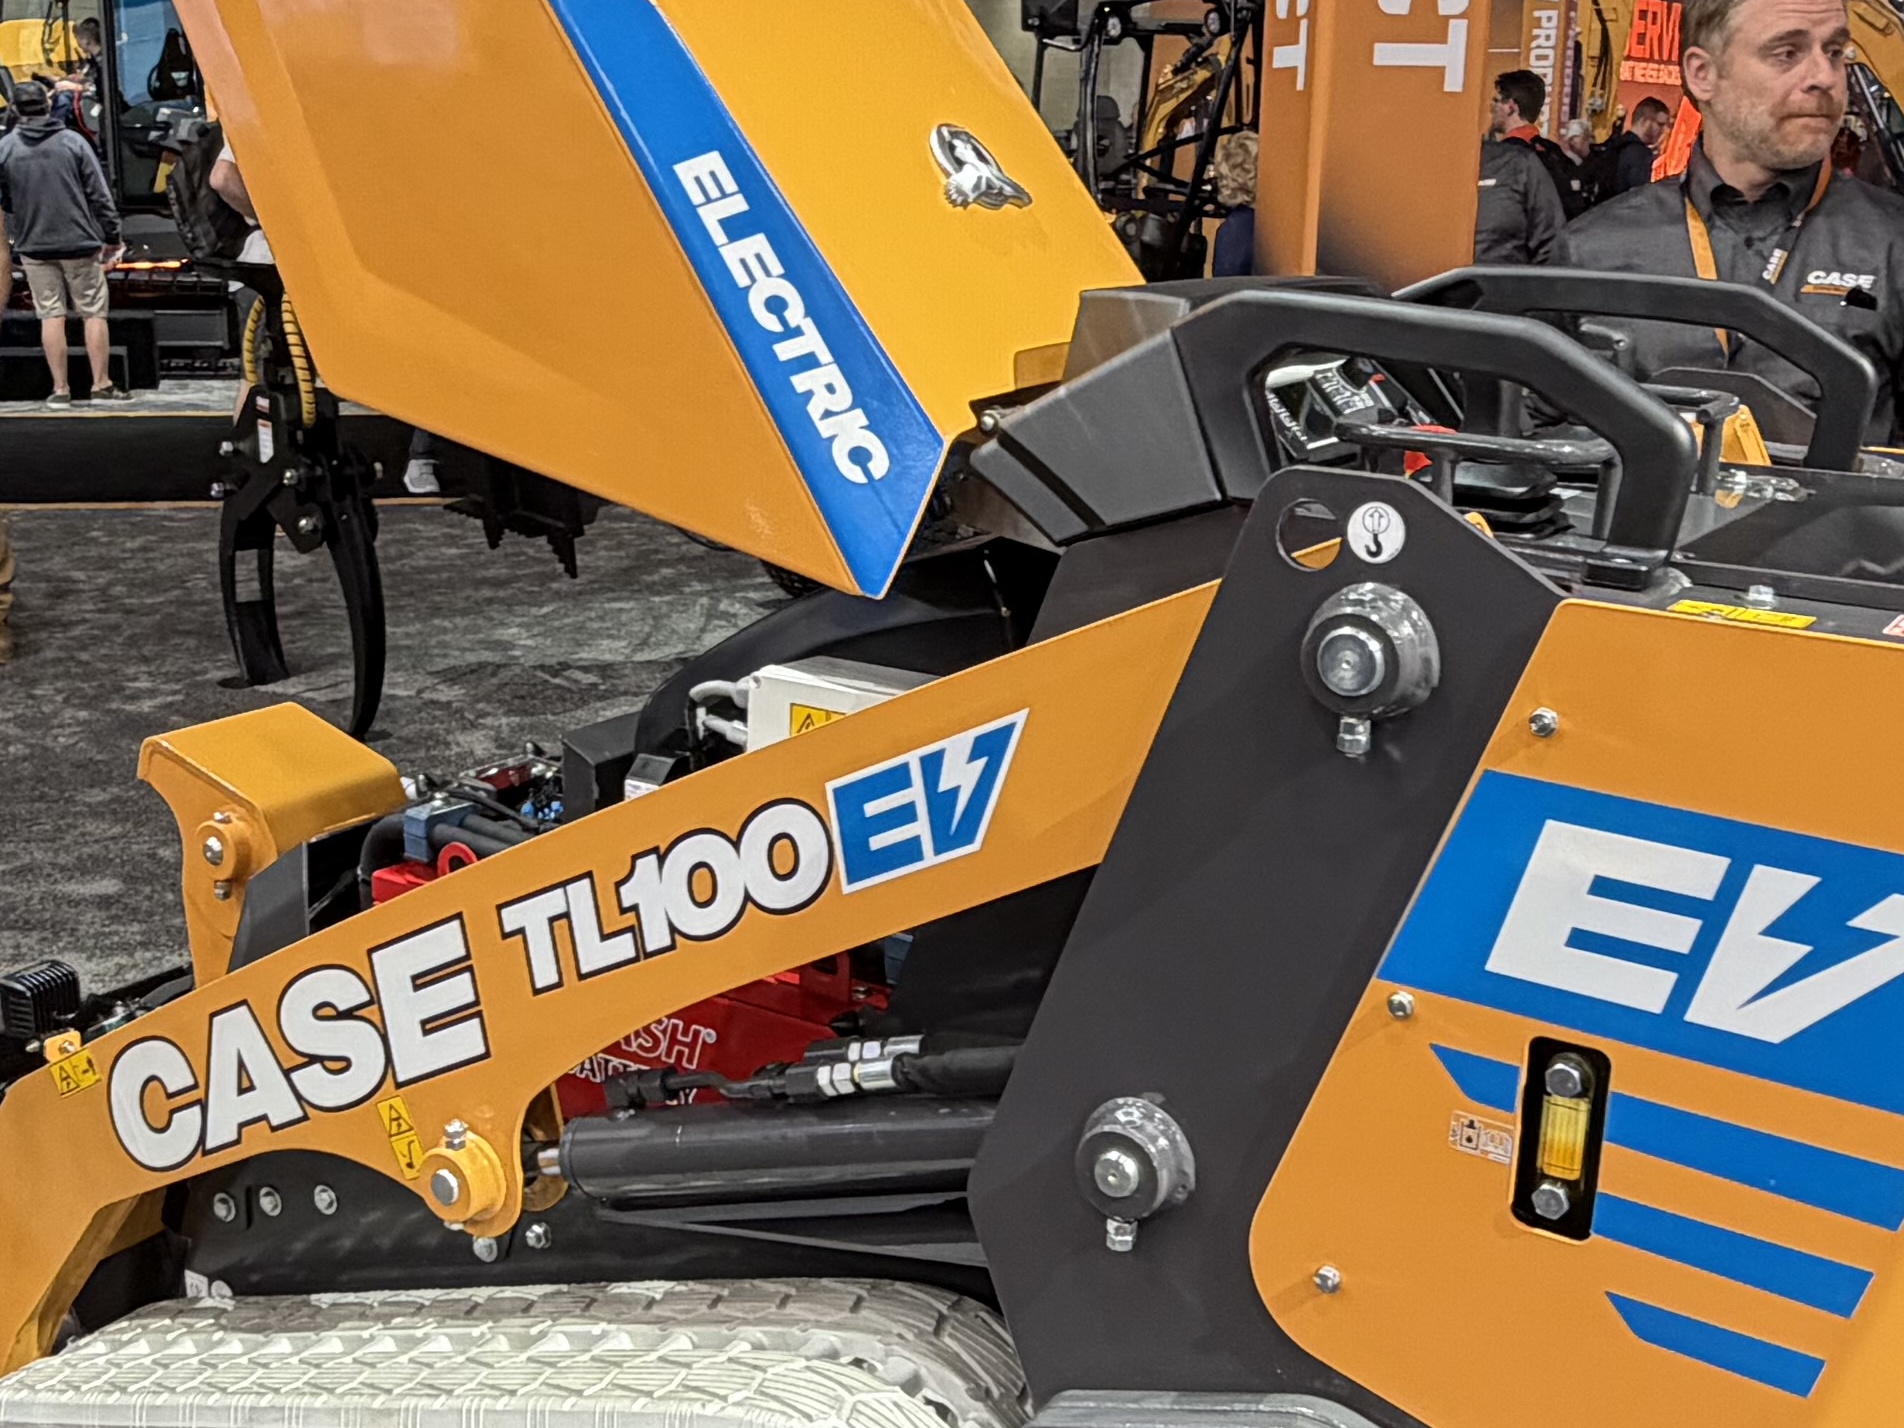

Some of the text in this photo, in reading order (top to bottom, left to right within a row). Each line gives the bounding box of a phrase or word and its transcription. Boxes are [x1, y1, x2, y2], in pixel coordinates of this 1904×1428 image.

[1529, 8, 1559, 139] PROD
[672, 150, 890, 484] ELECTRIC
[1807, 270, 1876, 289] CASE
[108, 912, 492, 1173] CASE
